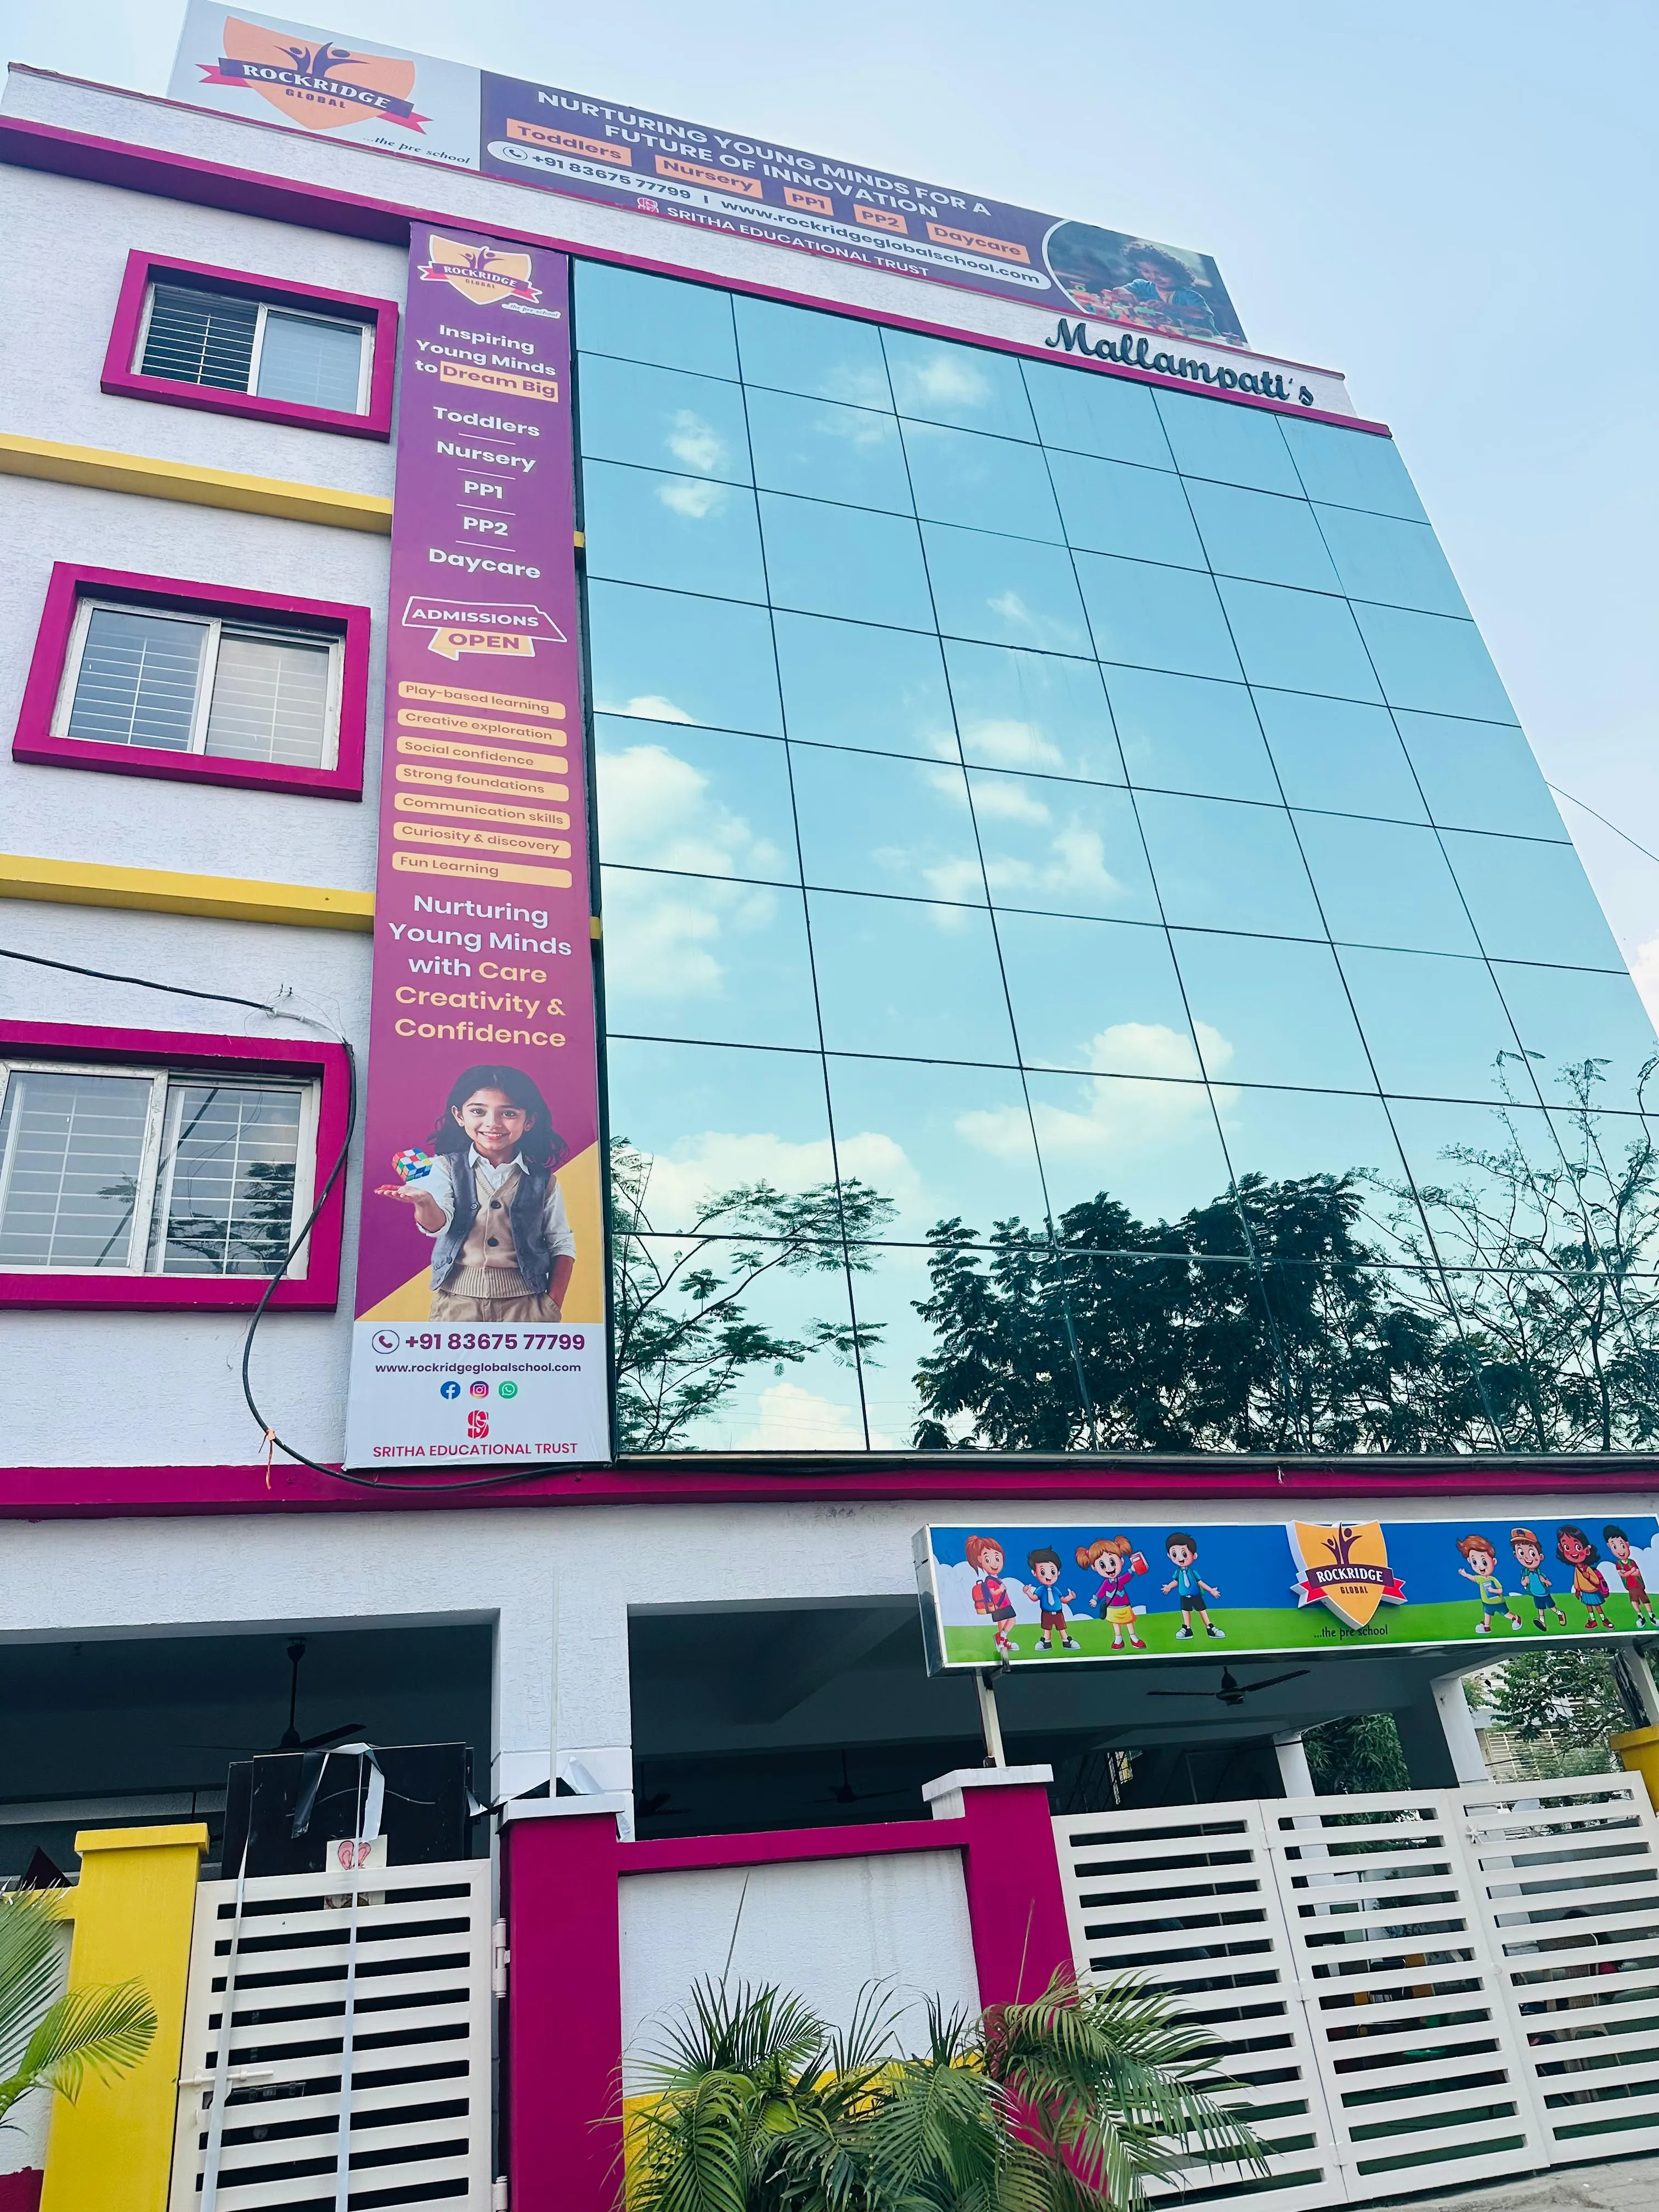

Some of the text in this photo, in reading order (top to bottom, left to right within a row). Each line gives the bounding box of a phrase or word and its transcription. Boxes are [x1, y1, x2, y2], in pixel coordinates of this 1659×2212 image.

[242, 64, 391, 109] ROCKRIDGE
[285, 88, 346, 109] GLOBAL
[398, 143, 421, 153] pre
[426, 149, 470, 163] school
[517, 126, 622, 159] Toddlers
[538, 91, 991, 216] NURTURING YOUNG MINDS FOR A
[605, 125, 938, 218] FUTURE OF INNOVATION
[663, 160, 753, 193] Nursery
[792, 194, 825, 209] PP1
[533, 155, 563, 169] +91
[569, 163, 631, 185] 83675
[636, 179, 691, 199] 77799
[721, 201, 1040, 284] www.rockridgeglobalschool.com
[862, 211, 899, 228] PP2
[667, 207, 929, 276] SRITHA EDUCATIONAL TRUST
[934, 227, 1021, 256] Daycare
[444, 266, 518, 287] ROCKRIDGE
[465, 279, 495, 289] GLOBAL
[439, 324, 534, 355] Inspiring
[416, 340, 556, 376] Young Minds
[1045, 318, 1314, 406] Mallampati's
[415, 360, 555, 398] to Dream Big
[433, 406, 540, 437] Toddlers
[437, 441, 536, 473] Nursery
[465, 480, 503, 499] PP1
[464, 516, 508, 536] PP2
[429, 549, 541, 579] Daycare
[411, 609, 539, 627] ADMISSIONS
[448, 633, 519, 649] OPEN
[406, 685, 549, 714] Play-based learning
[406, 713, 552, 740] Creative exploration
[405, 742, 534, 766] Social confidence
[403, 768, 545, 793] Strong foundations
[403, 798, 563, 825] Communication skills
[402, 826, 560, 854] Curiosity & discovery
[400, 856, 499, 878] Fun Learning
[414, 895, 549, 929] Nurturing
[388, 922, 572, 956] Young Minds
[408, 956, 548, 983] with Care
[395, 986, 566, 1019] Creativity &
[394, 1018, 566, 1047] Confidence
[405, 1333, 585, 1350] +91 83675 77799
[375, 1362, 582, 1375] www.rockridgeglobalschool.com
[373, 1443, 578, 1458] SRITHA EDUCATIONAL TRUST
[1316, 1567, 1383, 1583] ROCKRIDGE
[1340, 1585, 1368, 1594] GLOBAL
[1340, 1628, 1355, 1641] pre
[1358, 1624, 1388, 1636] school
